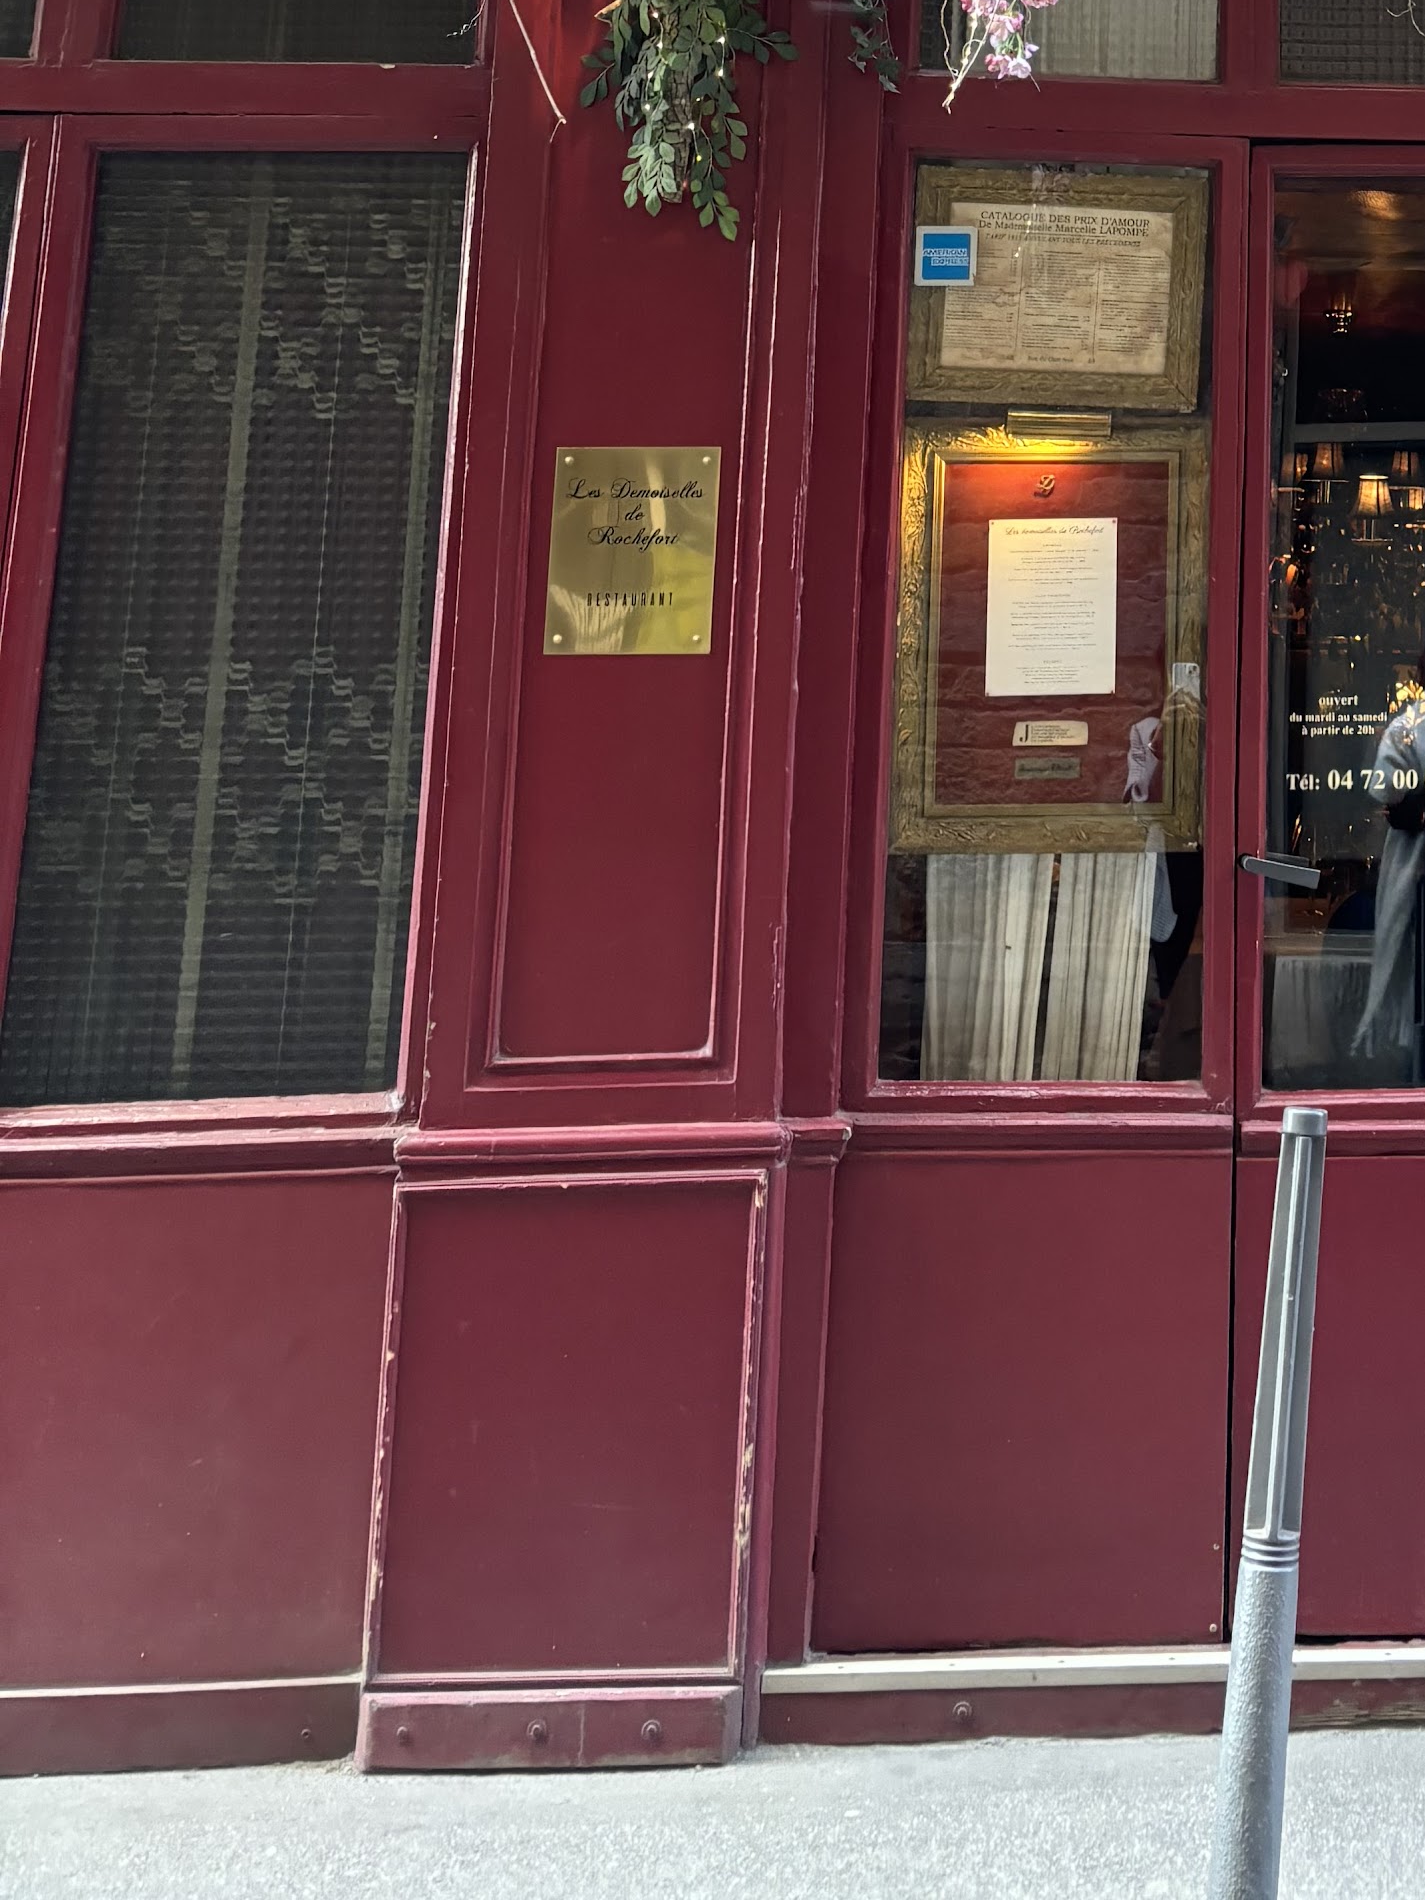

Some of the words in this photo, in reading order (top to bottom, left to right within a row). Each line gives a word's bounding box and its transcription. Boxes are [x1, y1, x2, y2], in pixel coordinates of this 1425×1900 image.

[981, 211, 1045, 223] CATALOGUE
[1049, 214, 1071, 224] DES
[1074, 216, 1098, 225] PRIX
[1101, 217, 1150, 228] D'AMOUR
[1055, 224, 1097, 234] Marcelle
[566, 478, 604, 499] Les
[610, 477, 706, 499] Demoiselles
[624, 503, 645, 521] de
[587, 525, 679, 553] Rochefort
[587, 592, 673, 607] RESTAURANT
[1318, 694, 1358, 706] ouvert
[1289, 712, 1302, 723] du
[1305, 712, 1336, 723] mardi
[1337, 714, 1350, 723] au
[1352, 711, 1388, 722] samedi
[1301, 724, 1308, 736] à
[1310, 724, 1341, 738] partir
[1342, 724, 1355, 735] de
[1356, 724, 1375, 736] 20h
[1286, 773, 1320, 791] Tél:
[1327, 769, 1353, 790] 04
[1360, 769, 1386, 790] 72
[1392, 769, 1418, 790] 00
